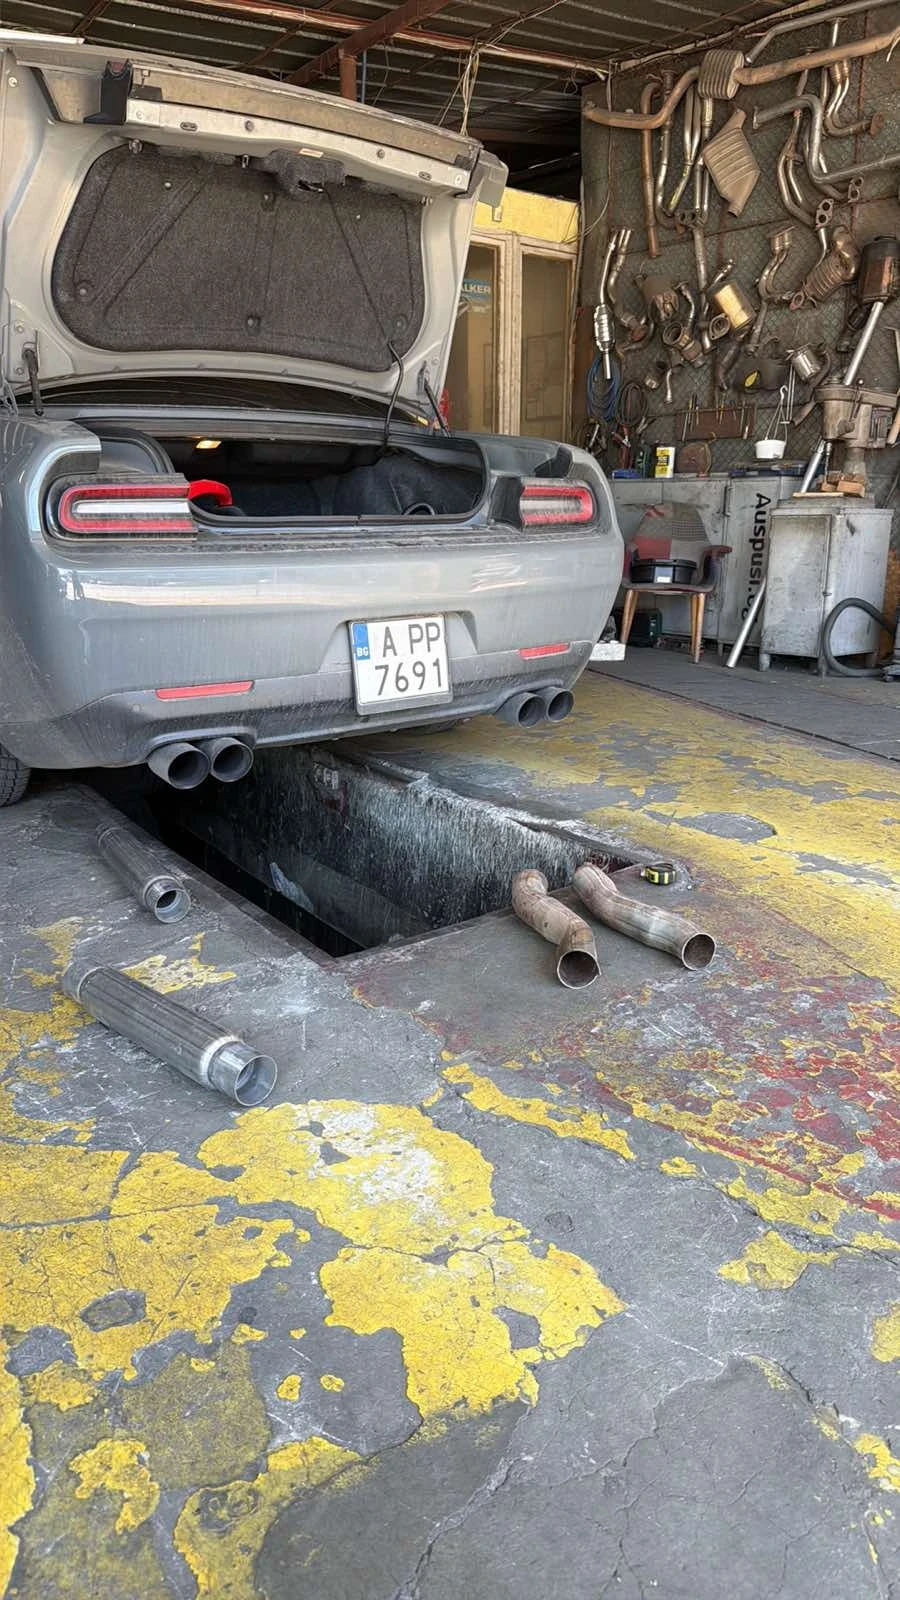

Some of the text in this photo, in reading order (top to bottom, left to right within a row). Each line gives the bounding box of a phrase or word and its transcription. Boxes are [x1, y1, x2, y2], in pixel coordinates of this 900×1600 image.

[356, 647, 369, 657] BG
[382, 622, 441, 658] A PP
[374, 658, 442, 696] 7691
